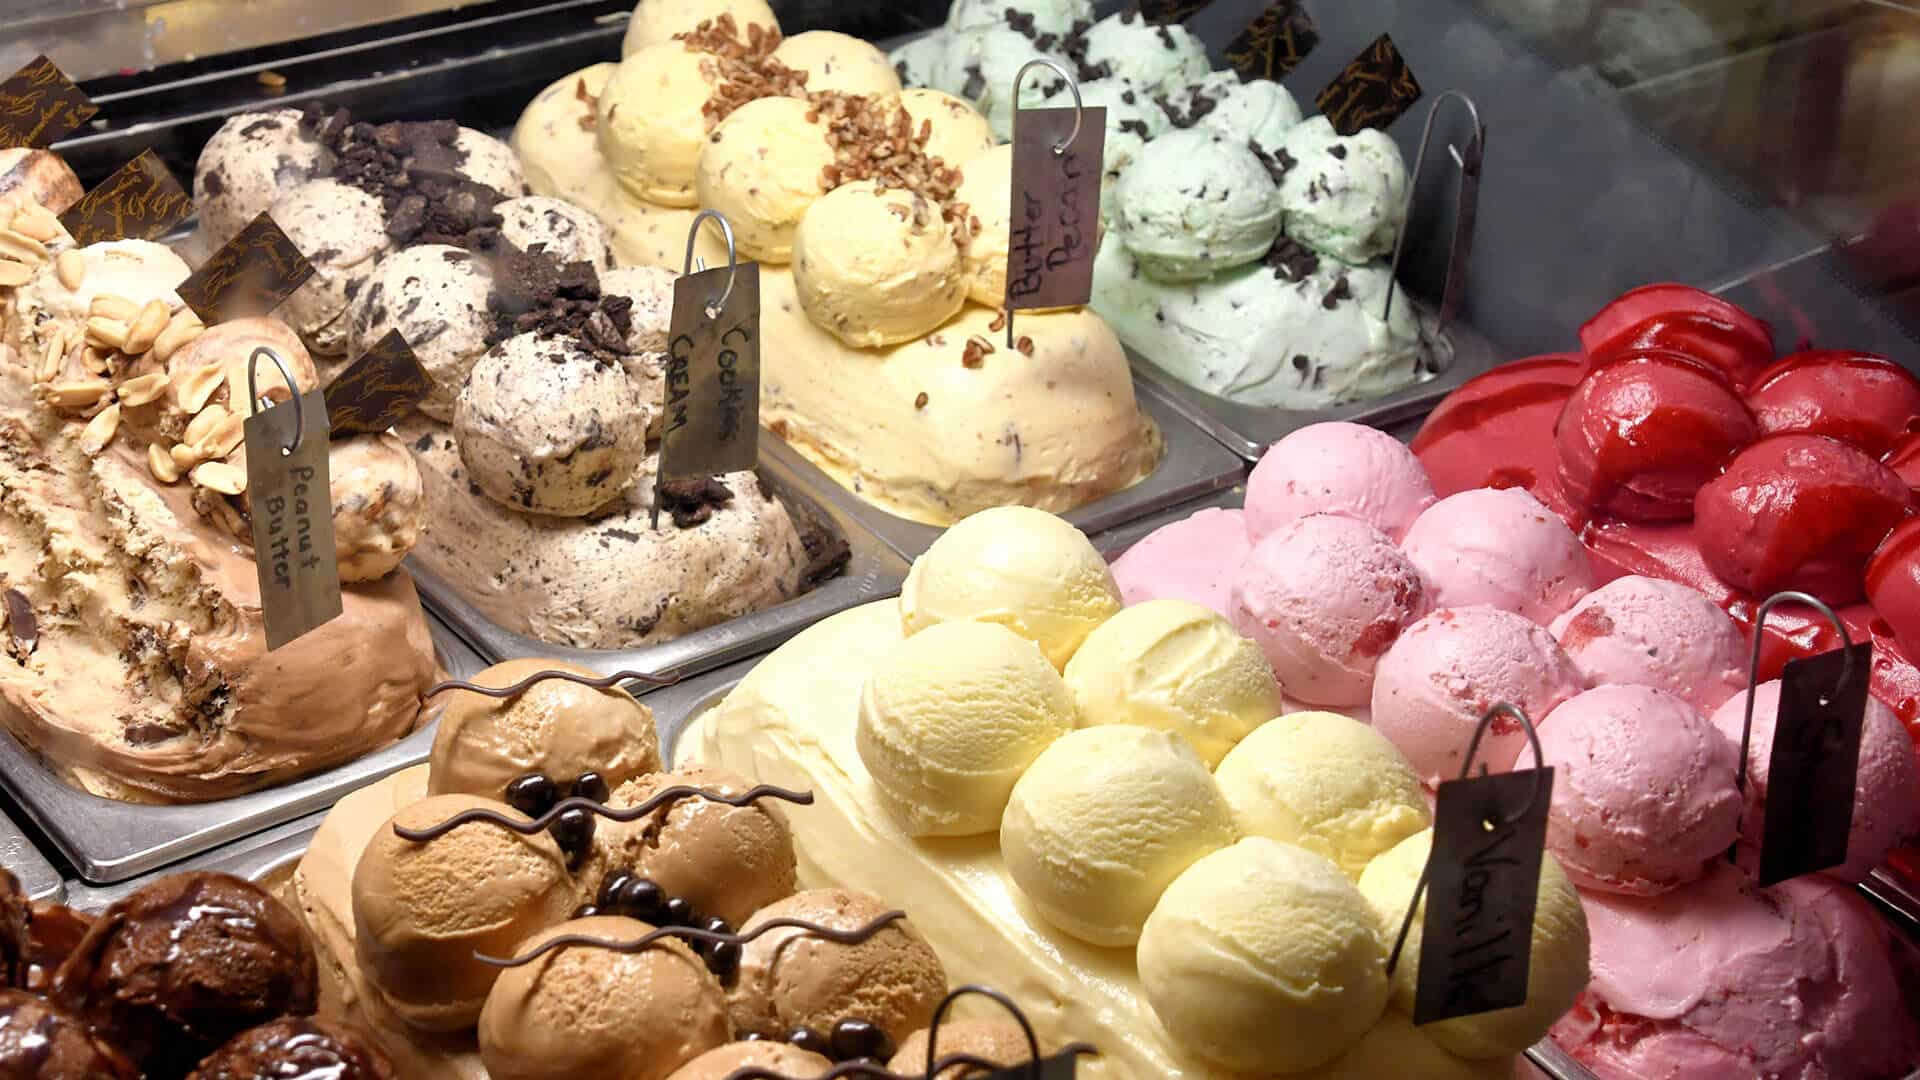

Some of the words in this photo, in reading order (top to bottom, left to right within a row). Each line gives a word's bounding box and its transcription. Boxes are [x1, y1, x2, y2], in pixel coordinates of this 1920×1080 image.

[1009, 192, 1044, 299] Butter
[1046, 153, 1082, 272] Pecan
[265, 497, 289, 590] Butter
[290, 466, 320, 570] Peanut
